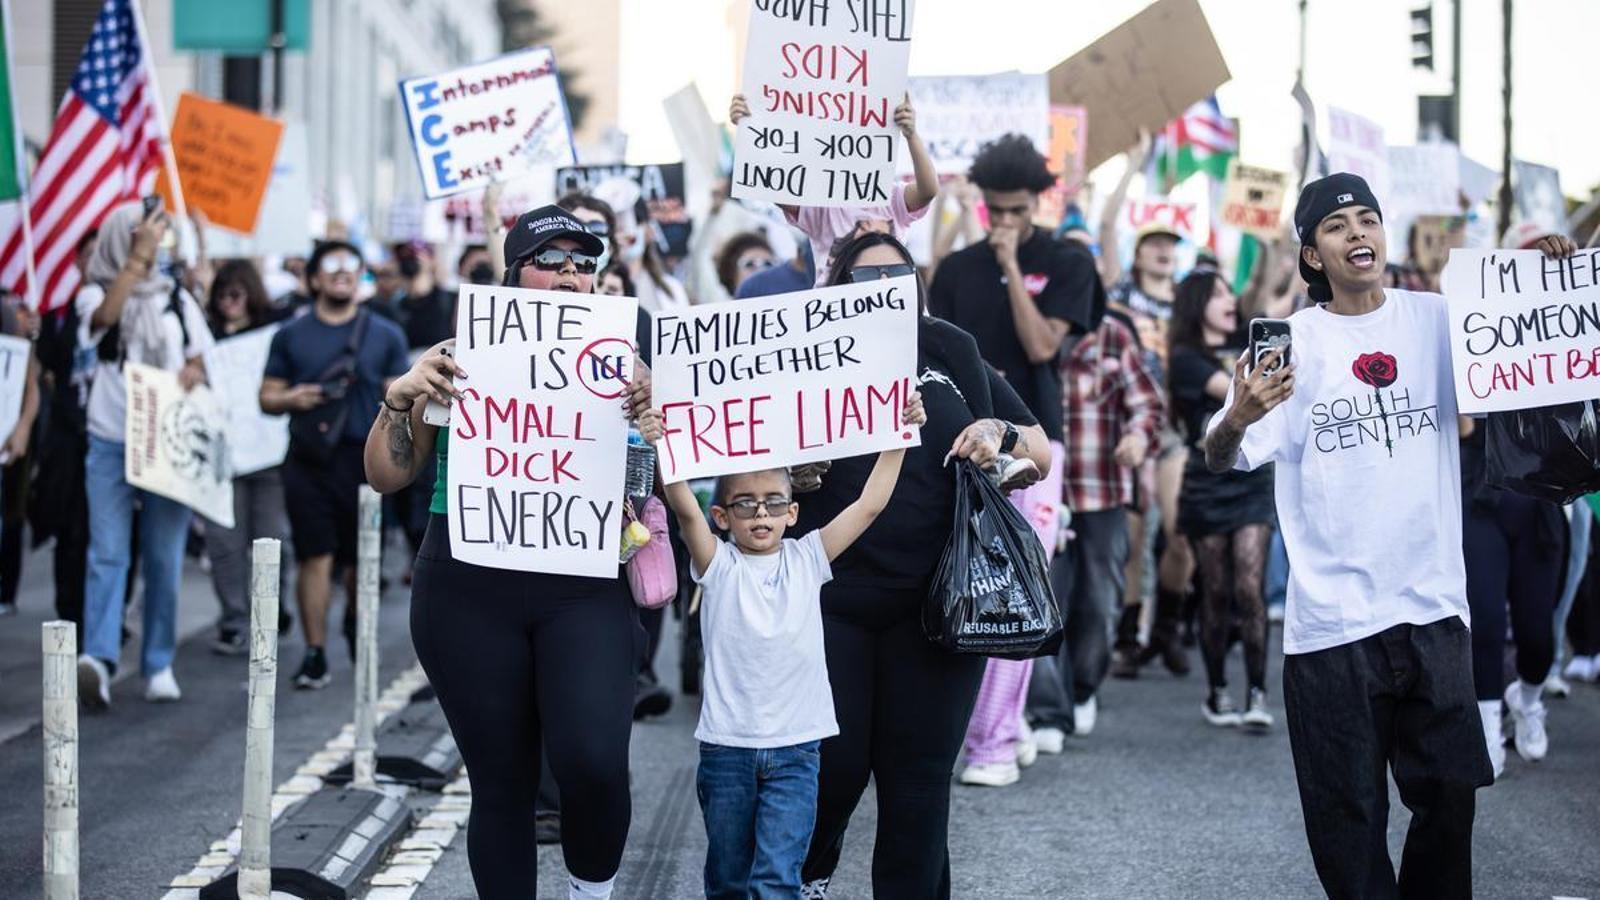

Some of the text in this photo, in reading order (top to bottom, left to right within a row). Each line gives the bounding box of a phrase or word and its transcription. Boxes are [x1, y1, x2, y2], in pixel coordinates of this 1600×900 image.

[846, 0, 911, 42] THIS
[781, 42, 868, 87] KIDS
[421, 107, 516, 147] Camps
[763, 84, 888, 128] MISSING
[747, 125, 800, 154] FOR
[814, 134, 893, 162] LOOK
[432, 150, 503, 190] Exist
[1481, 254, 1521, 299] I'M
[469, 293, 592, 350] HATE
[657, 287, 906, 356] FAMILIES BELONG
[530, 347, 628, 389] IS ICE
[687, 335, 861, 397] TOGETHER
[1467, 353, 1558, 399] CAN'T
[456, 388, 596, 443] SMALL
[661, 377, 913, 476] FREE LIAM!
[485, 447, 581, 484] DICK
[458, 484, 613, 550] ENERGY
[963, 621, 1019, 635] REUSABLE
